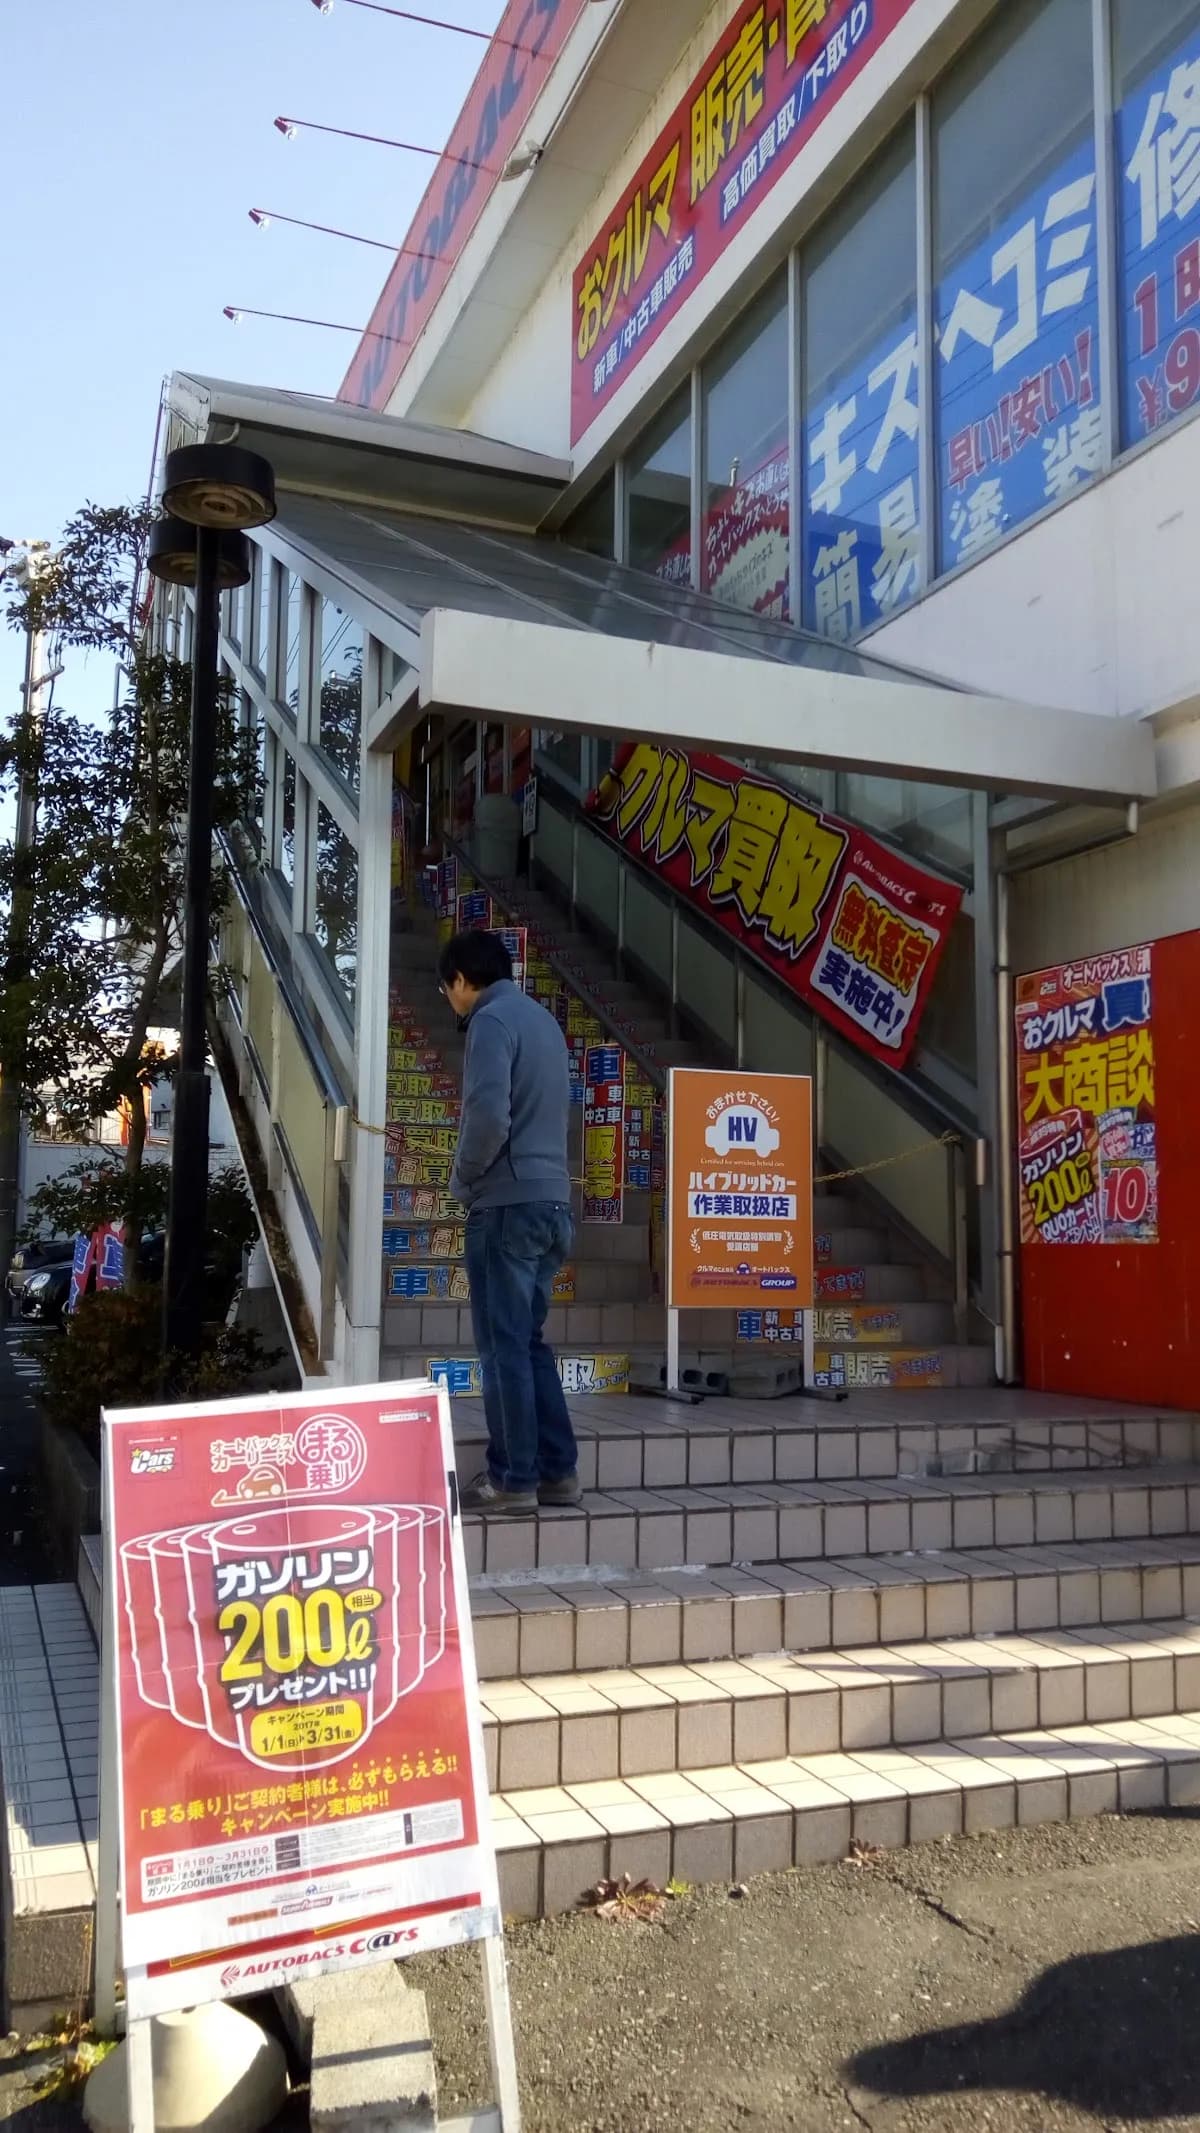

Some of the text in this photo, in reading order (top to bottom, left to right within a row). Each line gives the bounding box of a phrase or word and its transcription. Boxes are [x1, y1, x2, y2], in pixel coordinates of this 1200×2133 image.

[594, 0, 868, 394] 新車/中古車販売 高価買取/下取り
[576, 140, 682, 361] おクルマ
[948, 327, 1094, 495] 早い!安い!
[1063, 952, 1131, 990] オートバックス
[819, 948, 906, 1038] 実施中!
[1023, 997, 1096, 1051] おクルマ
[1023, 1029, 1155, 1123] 大商談
[706, 1090, 781, 1123] おまかせ下さい!
[728, 1116, 758, 1142] HV
[1023, 1131, 1085, 1184] ガソリン
[688, 1170, 797, 1193] ハイブリッドカー
[694, 1193, 790, 1217] 作業取扱店
[761, 1278, 795, 1287] GROUP
[210, 1432, 295, 1455] オートバックス
[303, 1422, 356, 1464] まる
[211, 1449, 297, 1474] カーリース
[307, 1462, 351, 1490] 乗り
[216, 1548, 371, 1600] ガソリン
[351, 1593, 375, 1608] 相当
[230, 1668, 368, 1708] プレゼント!!
[267, 1704, 345, 1726] キャンペーン期間
[293, 1718, 320, 1731] 2017年
[221, 1789, 390, 1838] キャンペーン実施中!!
[243, 1945, 346, 1978] AUTOBACS
